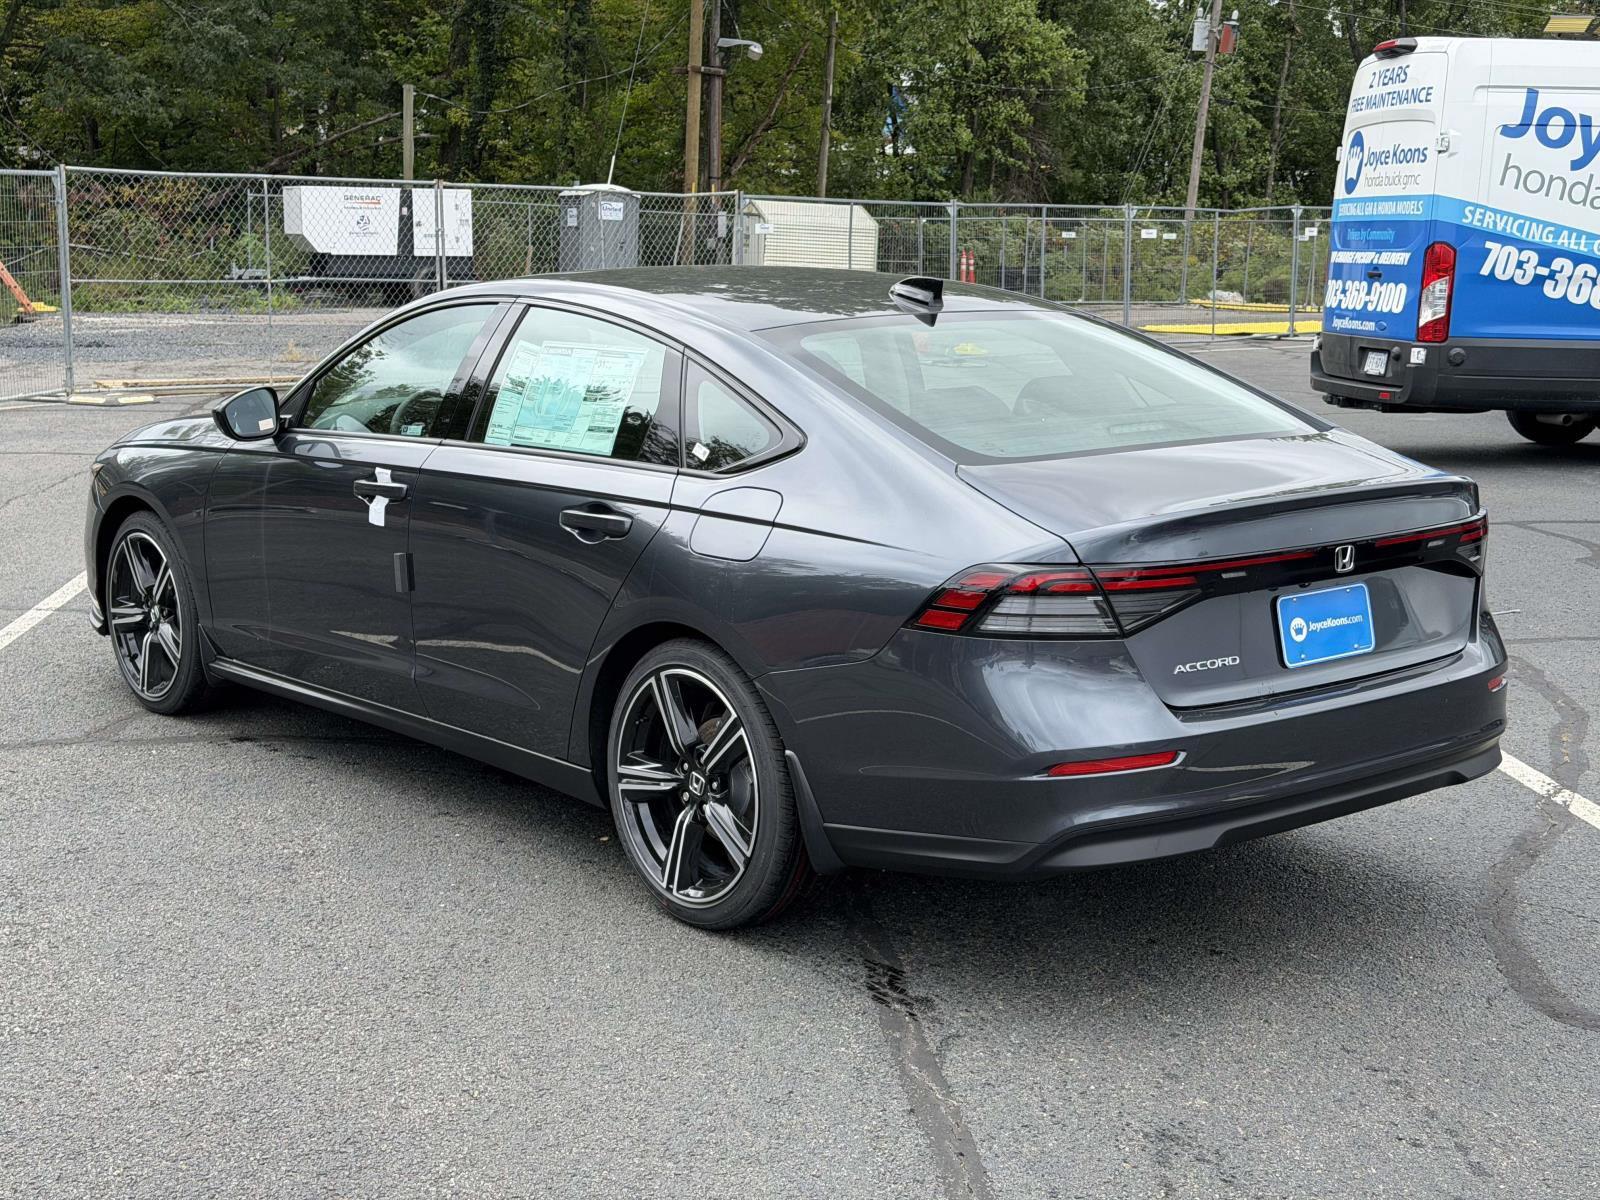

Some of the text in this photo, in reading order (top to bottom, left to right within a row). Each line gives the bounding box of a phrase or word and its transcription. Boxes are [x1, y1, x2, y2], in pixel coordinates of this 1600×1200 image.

[1369, 64, 1411, 89] 2 YEARS
[1351, 86, 1434, 112] FREE MAINTENANCE
[1499, 87, 1600, 172] Joy
[1364, 143, 1428, 172] Joyce Koons
[1364, 171, 1384, 188] honda
[1402, 174, 1422, 190] gmc
[1377, 201, 1396, 215] HONDA
[1396, 200, 1424, 215] MODELS
[1462, 206, 1555, 244] SERVICING
[1556, 229, 1588, 252] ALL
[1378, 252, 1412, 266] DELIVERY
[1332, 315, 1376, 331] JoyceKoons.com
[1308, 613, 1364, 632] JoyceKoons.com
[1173, 655, 1240, 675] ACCORD
